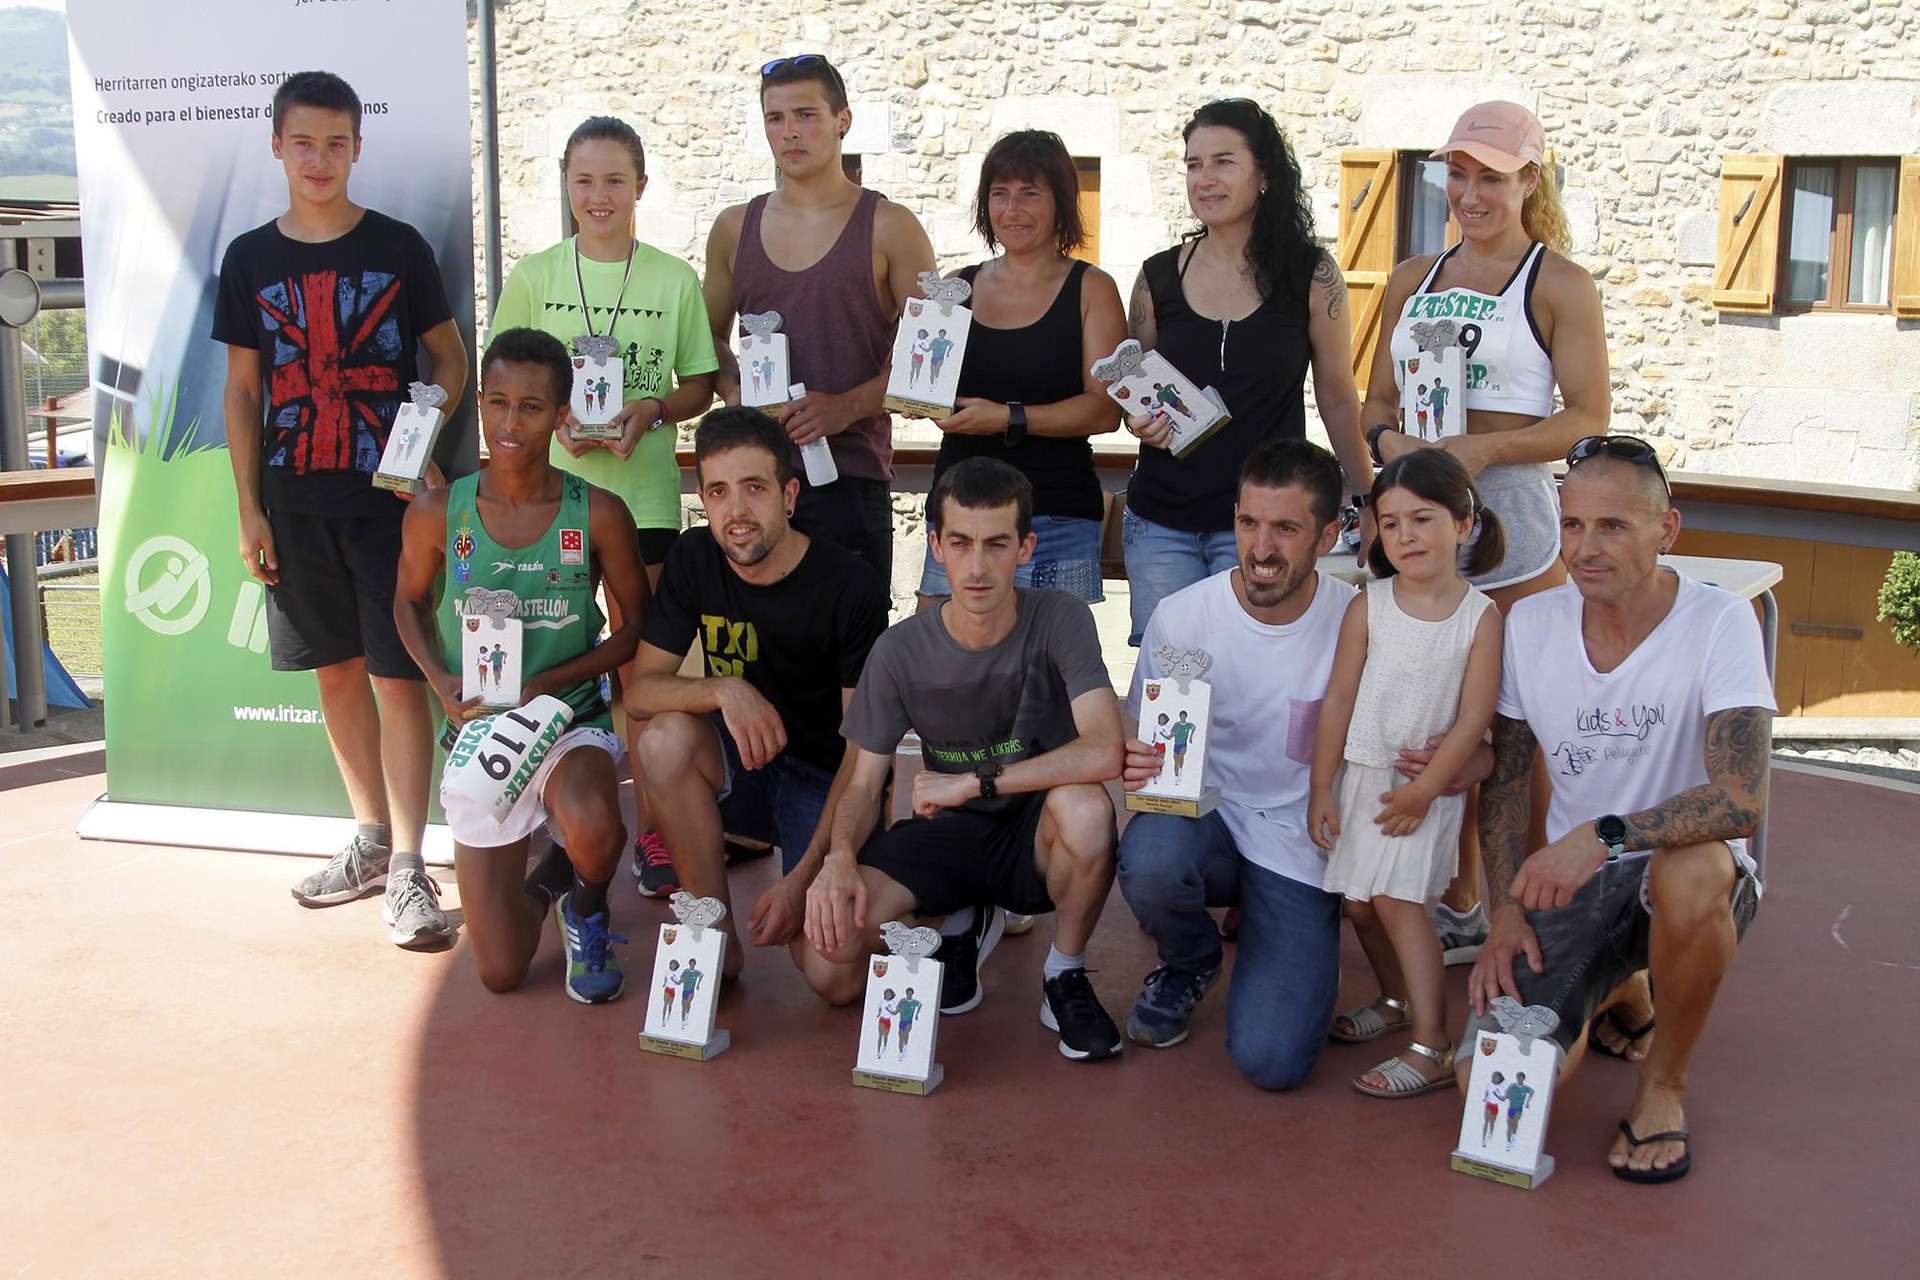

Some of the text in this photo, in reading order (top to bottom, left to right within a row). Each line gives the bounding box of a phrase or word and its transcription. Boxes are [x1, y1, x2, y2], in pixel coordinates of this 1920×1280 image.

[95, 71, 290, 91] Herritarren ongizaterako sort
[97, 108, 142, 123] Creado
[146, 110, 176, 126] para
[180, 106, 192, 121] el
[196, 105, 260, 121] bienestar
[264, 103, 273, 118] d
[512, 595, 569, 617] ASTELLÓN
[1577, 708, 1611, 732] Kids
[1615, 708, 1627, 727] &
[477, 711, 541, 781] 119
